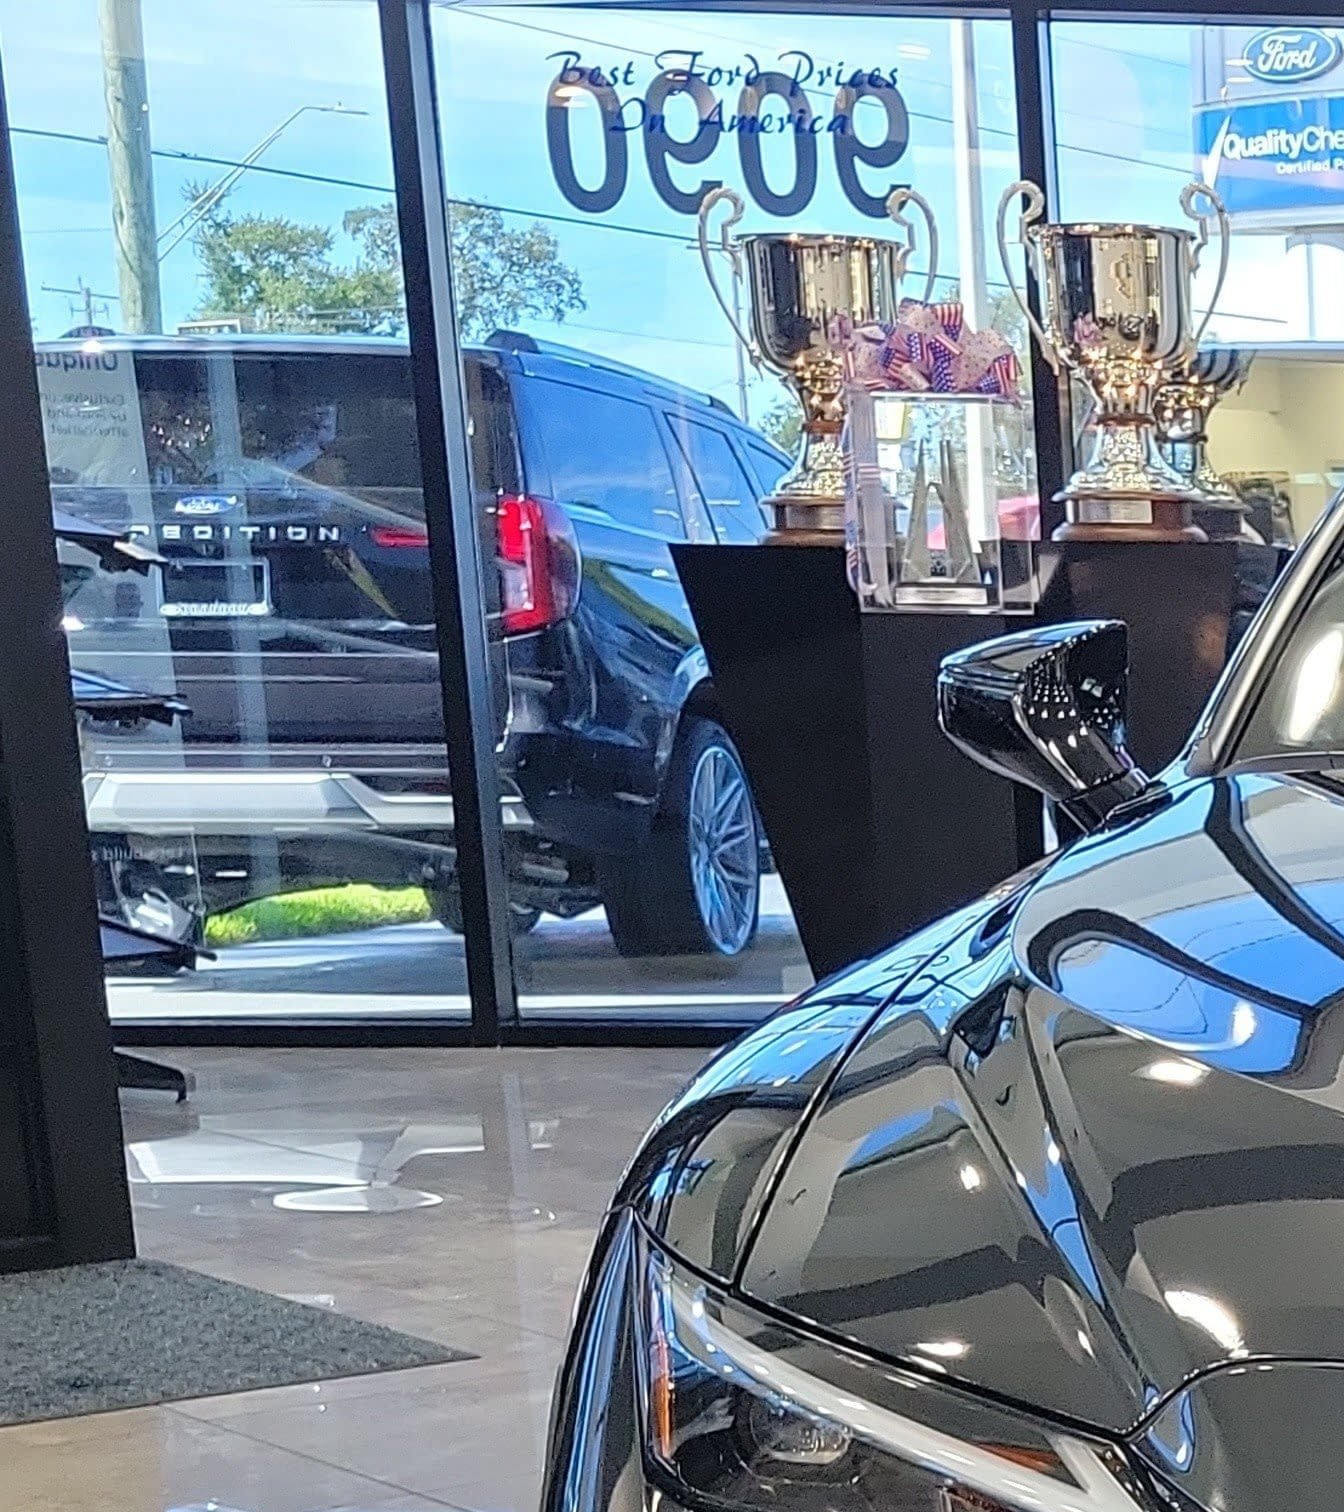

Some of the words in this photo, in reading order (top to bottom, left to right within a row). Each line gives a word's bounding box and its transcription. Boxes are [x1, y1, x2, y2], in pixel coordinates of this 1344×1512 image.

[1257, 34, 1317, 72] Ford
[545, 50, 636, 87] Best
[655, 49, 761, 93] Ford
[777, 50, 900, 97] Prices
[608, 97, 666, 132] In
[698, 98, 850, 136] America
[1276, 160, 1330, 175] Certified
